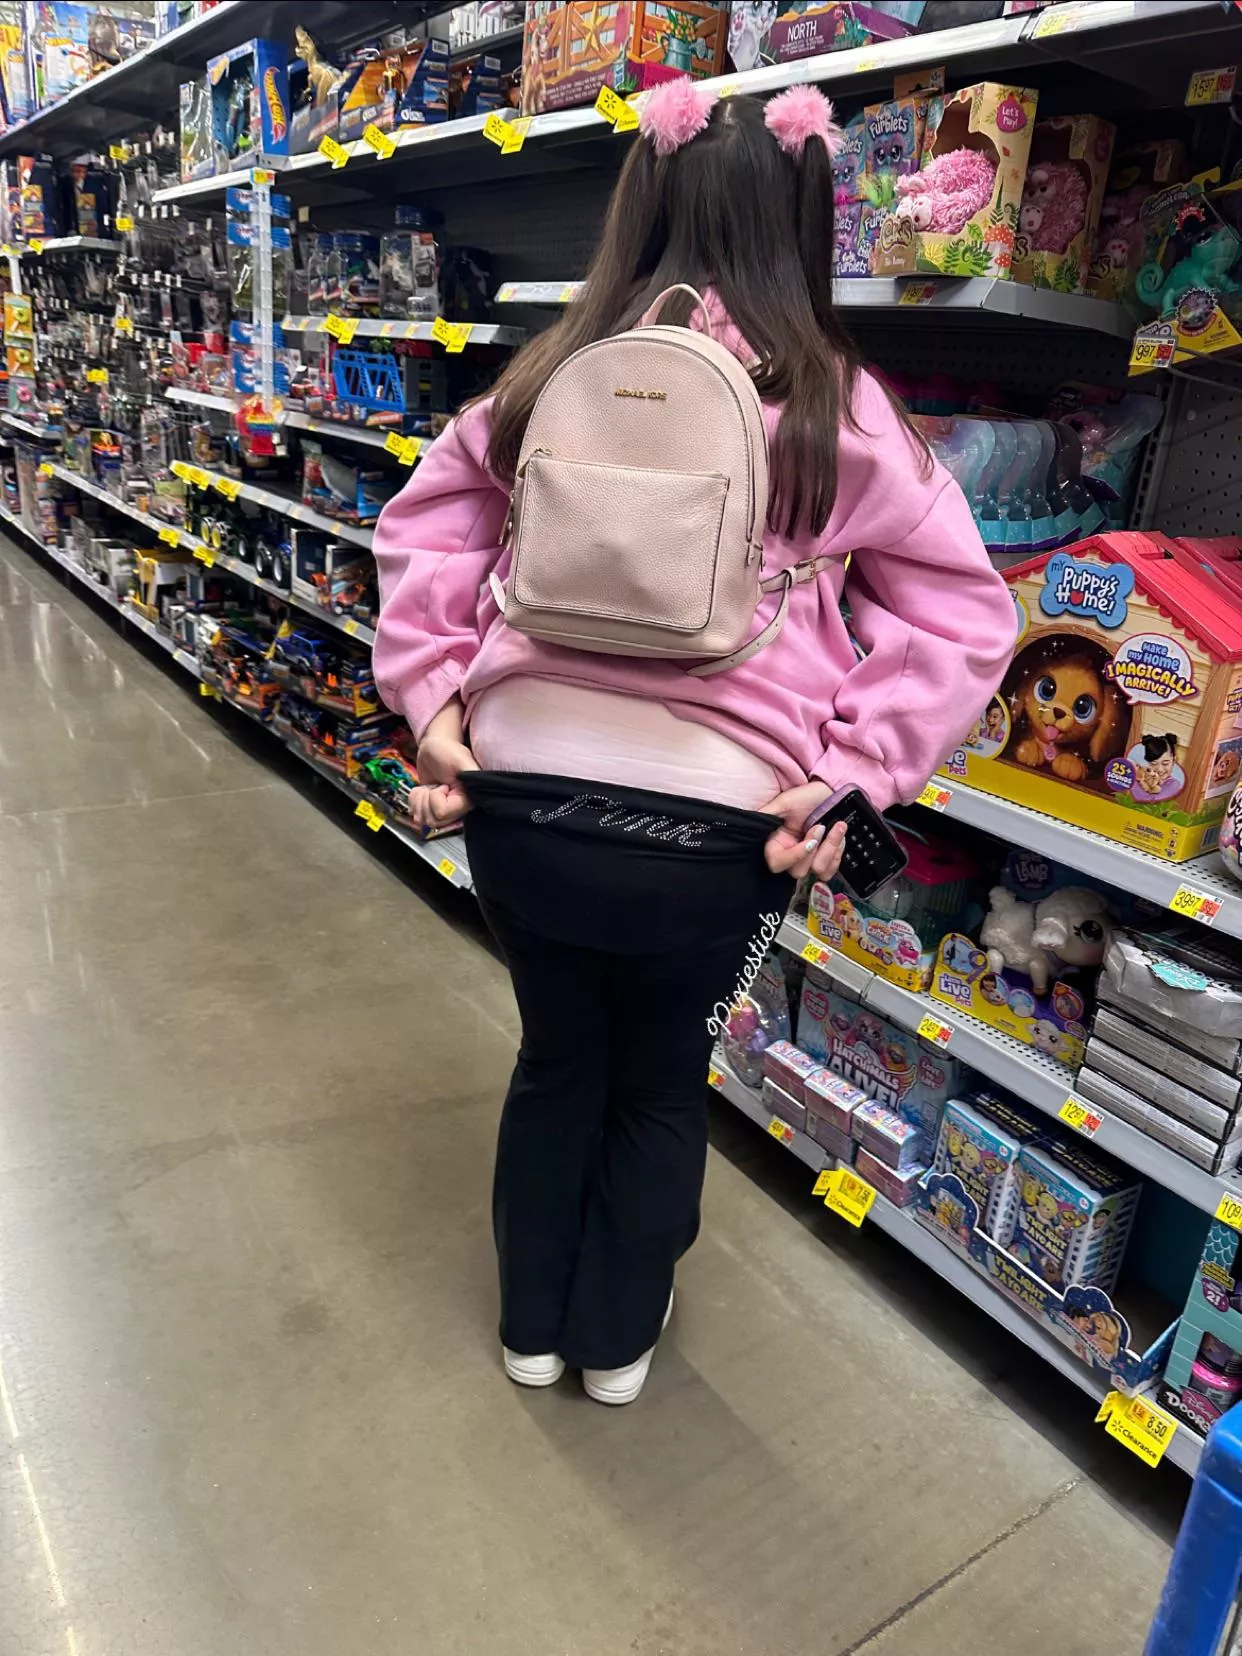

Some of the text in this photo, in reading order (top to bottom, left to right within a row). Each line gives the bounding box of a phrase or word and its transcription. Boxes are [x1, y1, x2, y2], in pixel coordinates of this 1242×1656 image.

[788, 20, 817, 41] NORTH
[1002, 106, 1019, 117] Let's
[1002, 116, 1019, 128] Play!
[868, 115, 909, 139] Furblets
[1062, 566, 1120, 598] Puppy's
[1107, 662, 1197, 696] I MAGICALLY
[1125, 676, 1172, 697] ARRIVE!
[1111, 762, 1132, 776] 25+
[820, 923, 842, 940] Live
[939, 979, 972, 1000] Live
[832, 1037, 900, 1090] HATCHIMALS
[826, 1055, 900, 1112] ALIVE!
[994, 1253, 1048, 1301] TWILIGHT
[1206, 1290, 1221, 1305] 21
[1146, 1416, 1168, 1438] 8.50
[1122, 1428, 1157, 1459] Clearance
